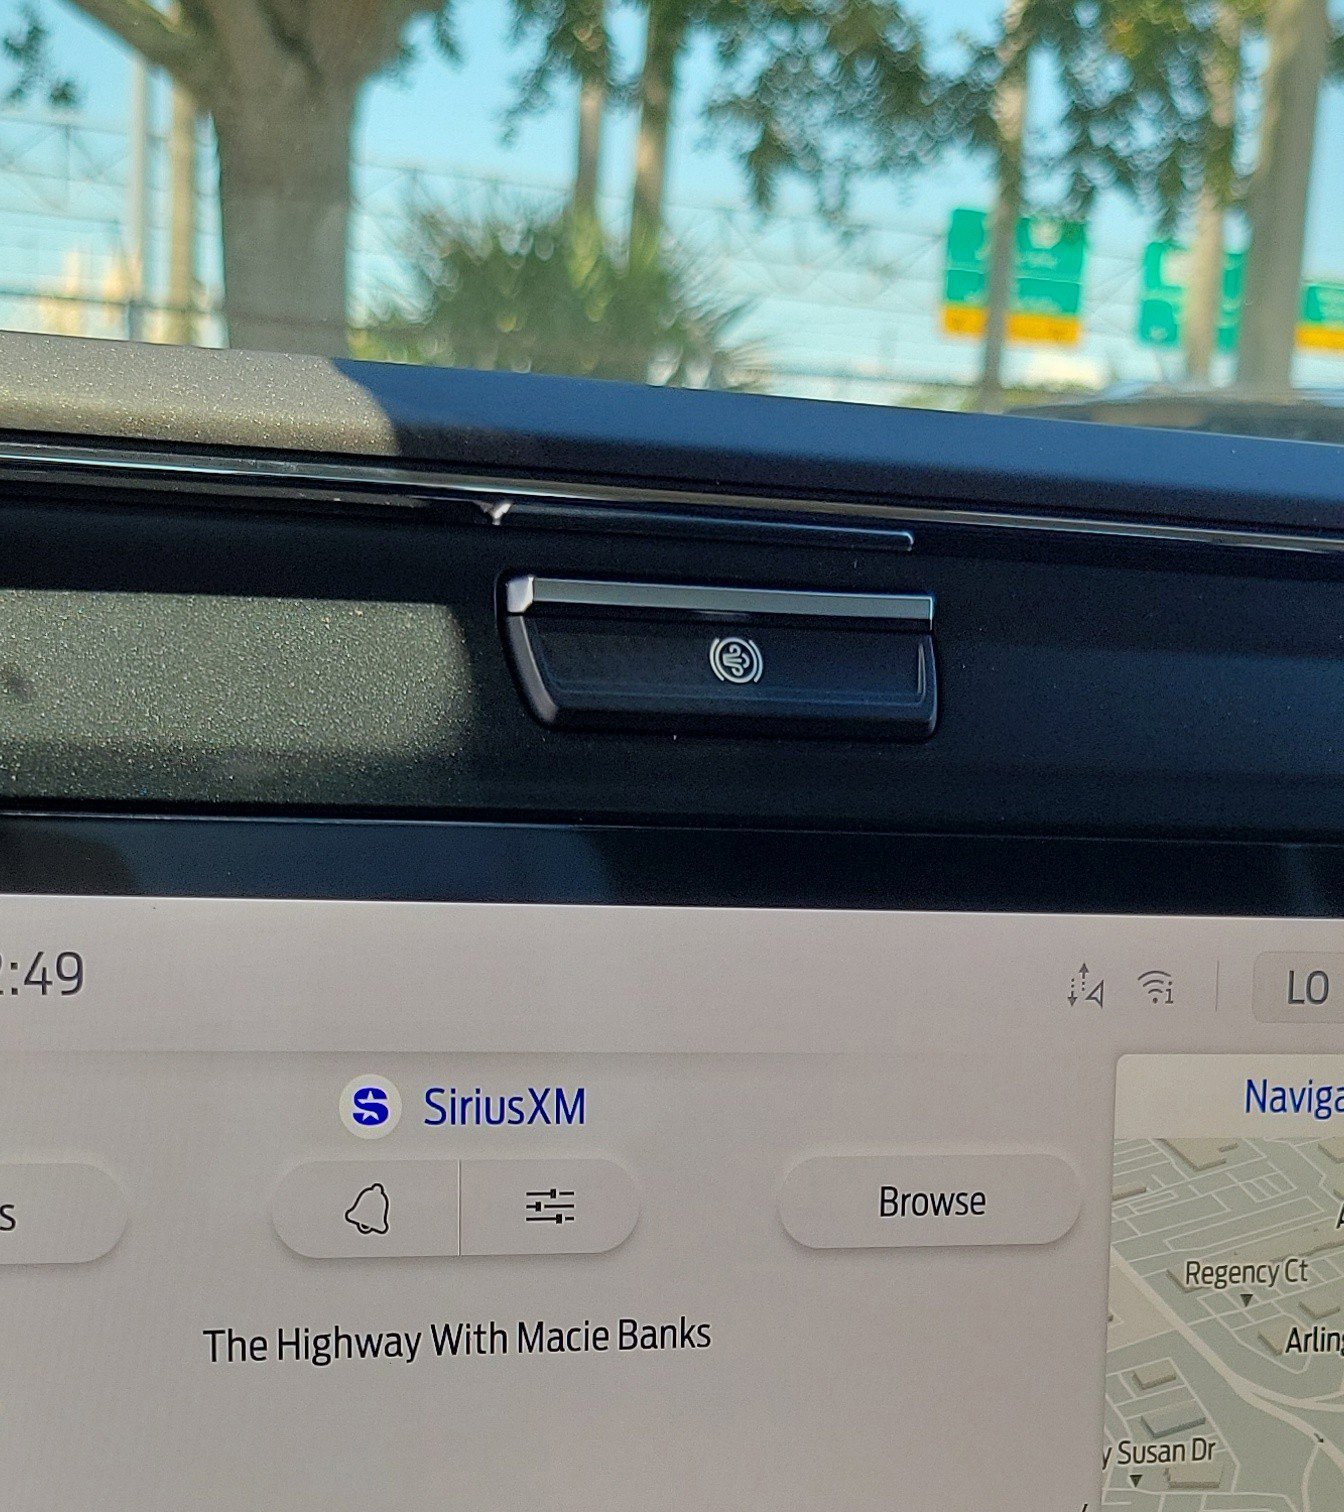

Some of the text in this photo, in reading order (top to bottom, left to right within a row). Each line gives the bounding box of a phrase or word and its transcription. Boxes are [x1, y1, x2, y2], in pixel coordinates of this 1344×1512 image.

[1287, 971, 1329, 1005] LO
[424, 1086, 586, 1128] SiriusXM
[879, 1186, 987, 1217] Browse
[1185, 1258, 1308, 1288] Regency Ct
[203, 1317, 712, 1367] The Highway With Macie Banks
[1117, 1440, 1186, 1465] Susan
[1192, 1437, 1217, 1461] Dr
